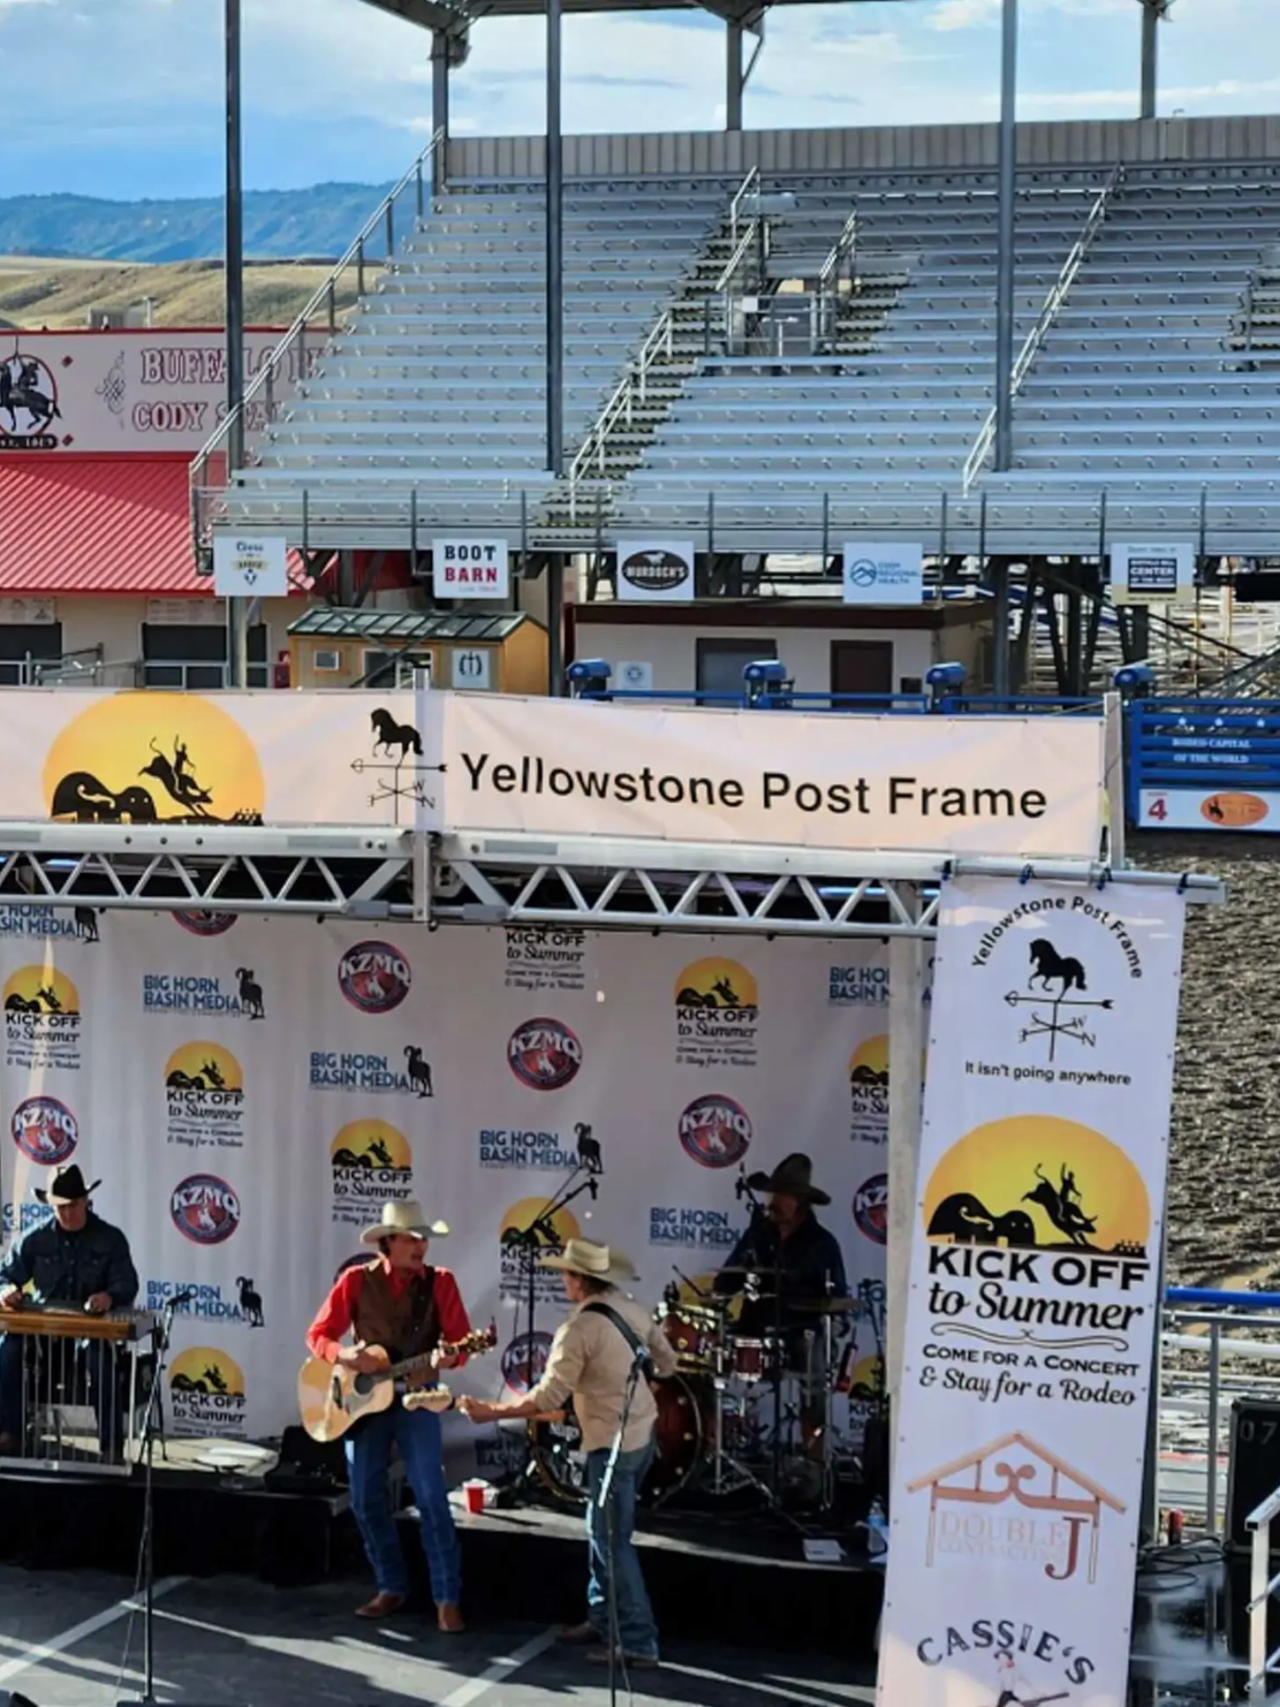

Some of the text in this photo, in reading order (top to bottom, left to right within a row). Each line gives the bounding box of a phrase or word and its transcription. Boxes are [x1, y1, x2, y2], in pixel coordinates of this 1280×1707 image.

[132, 402, 207, 432] CODY
[444, 545, 497, 561] BOOT
[445, 567, 498, 583] BARN
[1130, 567, 1175, 576] CENTER
[461, 752, 1048, 818] Yellowstone Post Frame
[1147, 798, 1168, 821] 4
[28, 919, 75, 934] MEDIA
[507, 931, 587, 948] KICK OFF
[971, 896, 1143, 979] Yellowstone Post Frame
[341, 953, 410, 988] KZMQ
[829, 967, 856, 983] BIG
[144, 975, 219, 993] BIG HORN
[829, 984, 877, 1001] BASIN
[144, 991, 240, 1010] BASIN MEDIA
[6, 1013, 44, 1027] KICK
[677, 1008, 759, 1023] KICK OFF
[511, 1030, 582, 1064] KZMQ
[311, 1052, 387, 1070] BIG HORN
[310, 1067, 410, 1088] BASIN MEDIA
[965, 1062, 1132, 1085] It isn't going anywhere
[167, 1090, 245, 1106] KICK OFF
[480, 1130, 559, 1148] BIG HORN
[480, 1147, 527, 1164] BASIN
[531, 1149, 579, 1167] MEDIA
[333, 1168, 413, 1184] KICK OFF
[174, 1186, 240, 1220] KZMQ
[651, 1207, 729, 1227] BIG HORN
[650, 1224, 741, 1244] BASIN MEDI
[928, 1245, 1150, 1290] KICK OFF
[147, 1281, 172, 1297] BIG
[195, 1301, 241, 1317] MEDIA
[929, 1281, 970, 1315] to
[975, 1282, 1144, 1331] Summer
[923, 1343, 1140, 1377] COME FOR A CONCERT
[919, 1365, 1136, 1407] & Stay for a Rodeo
[172, 1393, 210, 1407] KICK
[940, 1511, 1089, 1580] DOUBLE J
[916, 1618, 1096, 1686] CASSIE'S
